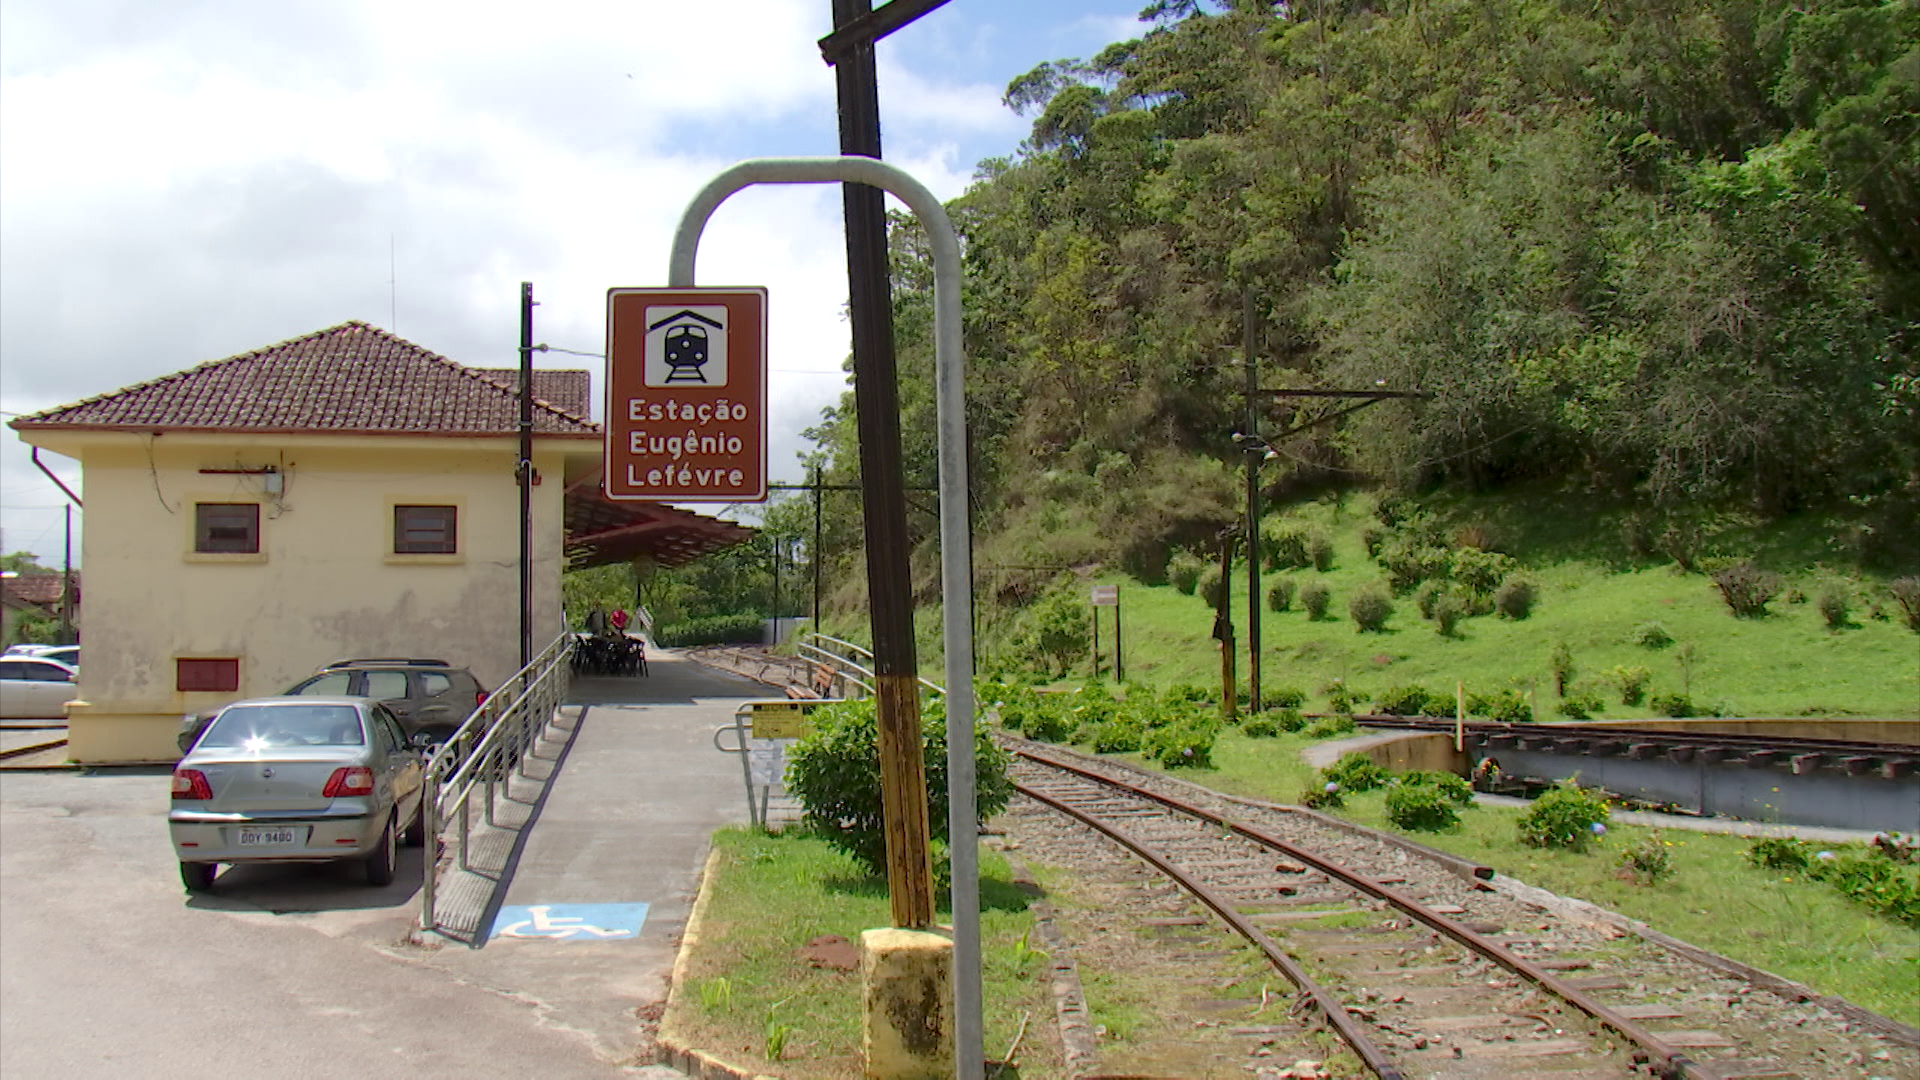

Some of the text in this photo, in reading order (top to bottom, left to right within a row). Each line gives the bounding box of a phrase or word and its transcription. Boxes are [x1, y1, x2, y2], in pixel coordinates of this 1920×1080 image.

[628, 399, 748, 425] Estação
[629, 429, 743, 460] Eugênio
[627, 461, 744, 487] Lefévre
